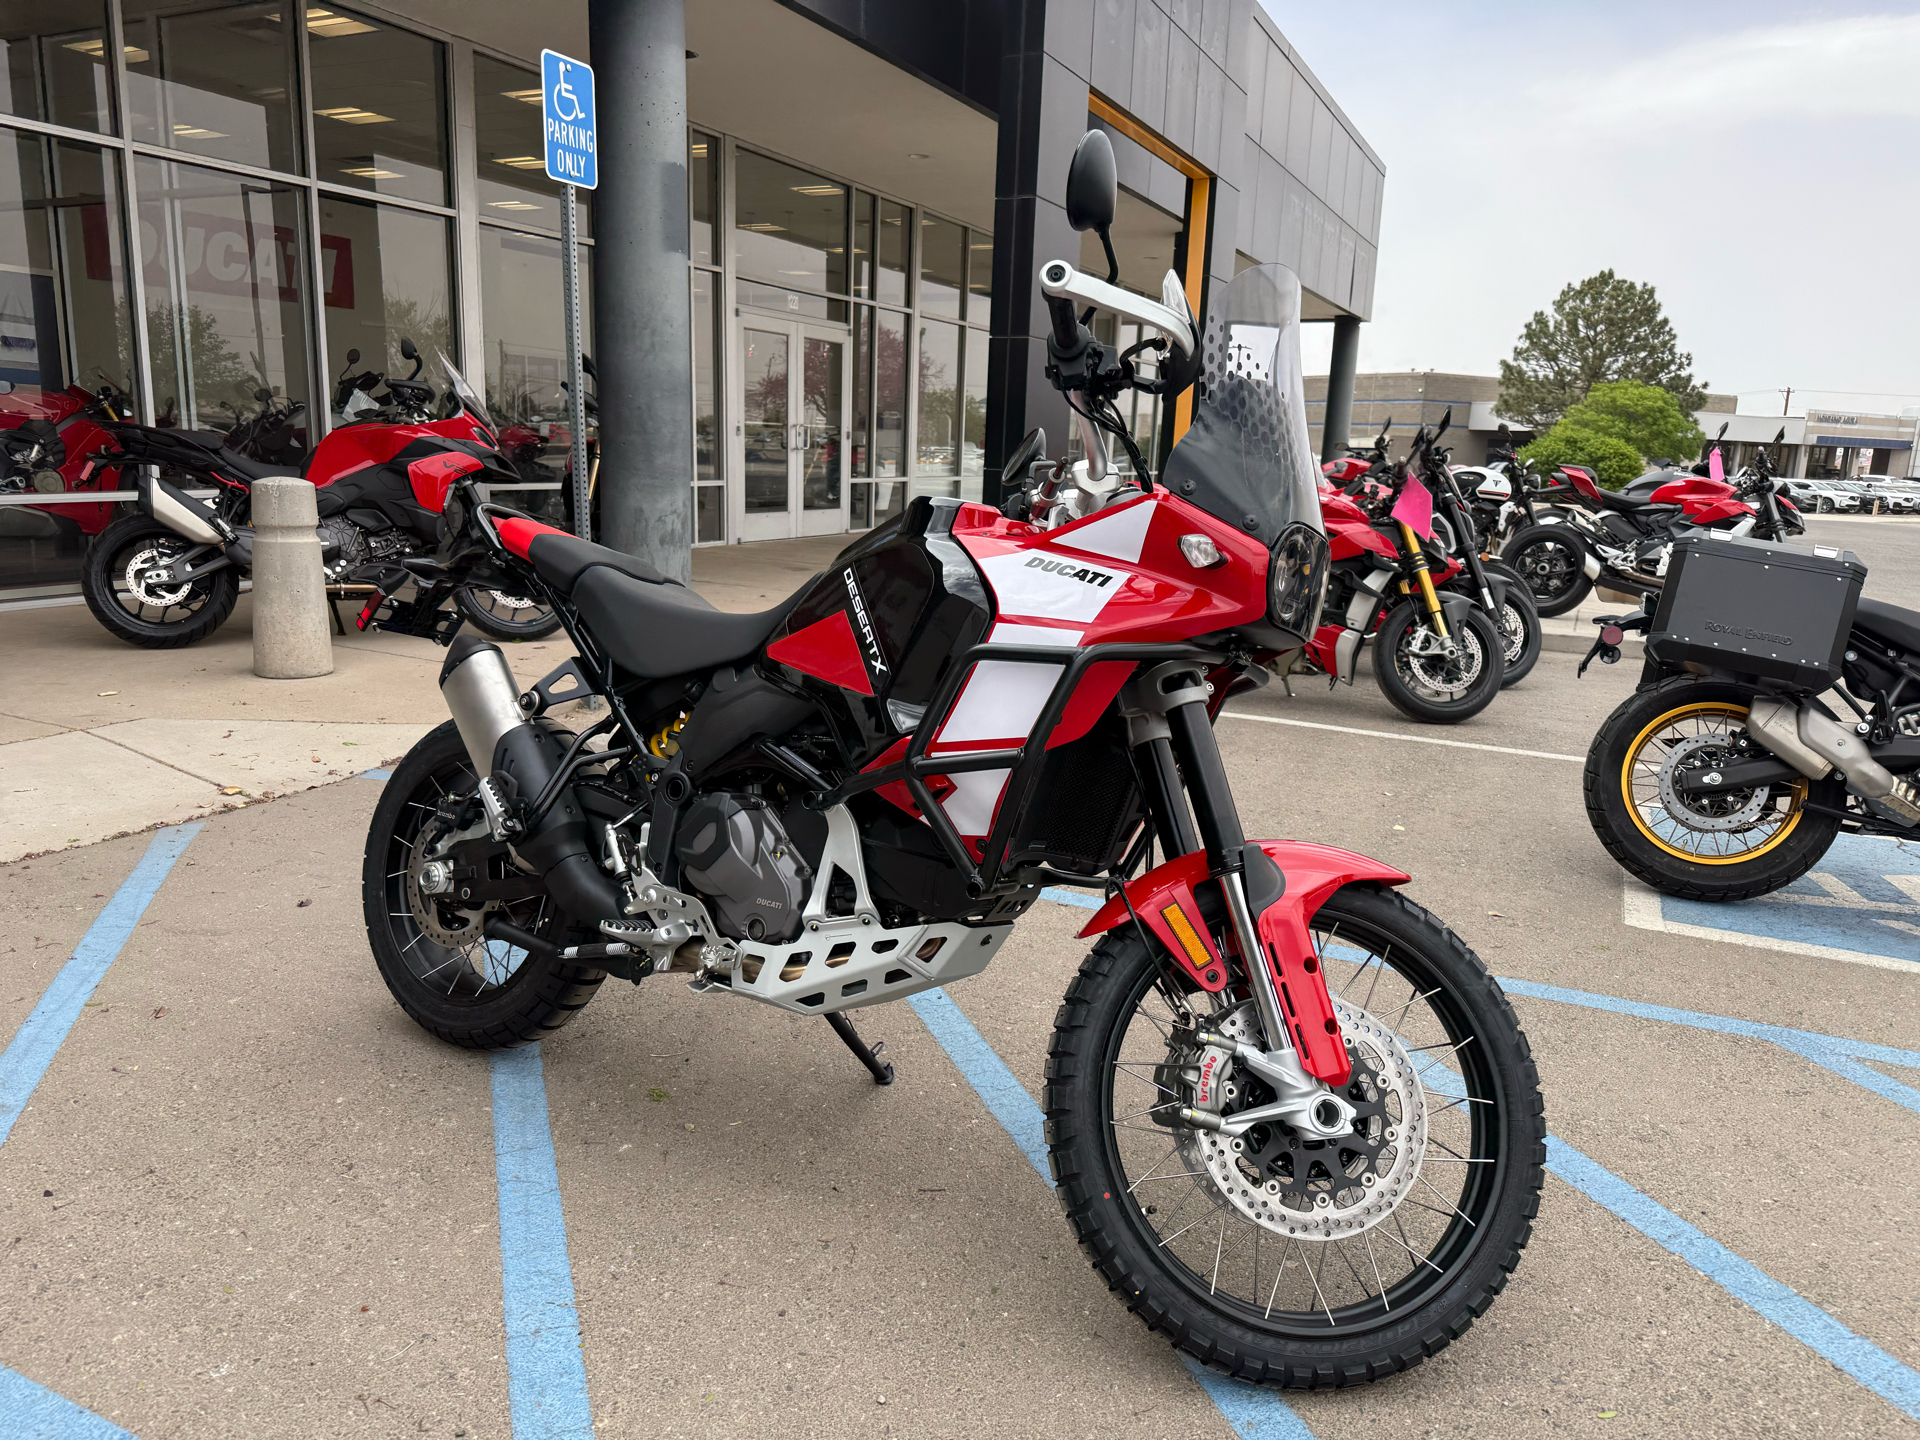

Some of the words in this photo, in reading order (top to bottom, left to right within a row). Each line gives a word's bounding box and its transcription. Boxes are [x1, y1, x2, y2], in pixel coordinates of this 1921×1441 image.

[548, 118, 593, 153] PARKING
[557, 149, 586, 178] ONLY
[1024, 556, 1113, 588] DUCATI
[843, 567, 887, 676] DESERTX
[1705, 620, 1742, 636] ROYAL
[1744, 627, 1793, 646] ENFIELD
[755, 897, 782, 910] DUCATI
[1198, 1056, 1217, 1103] brembo
